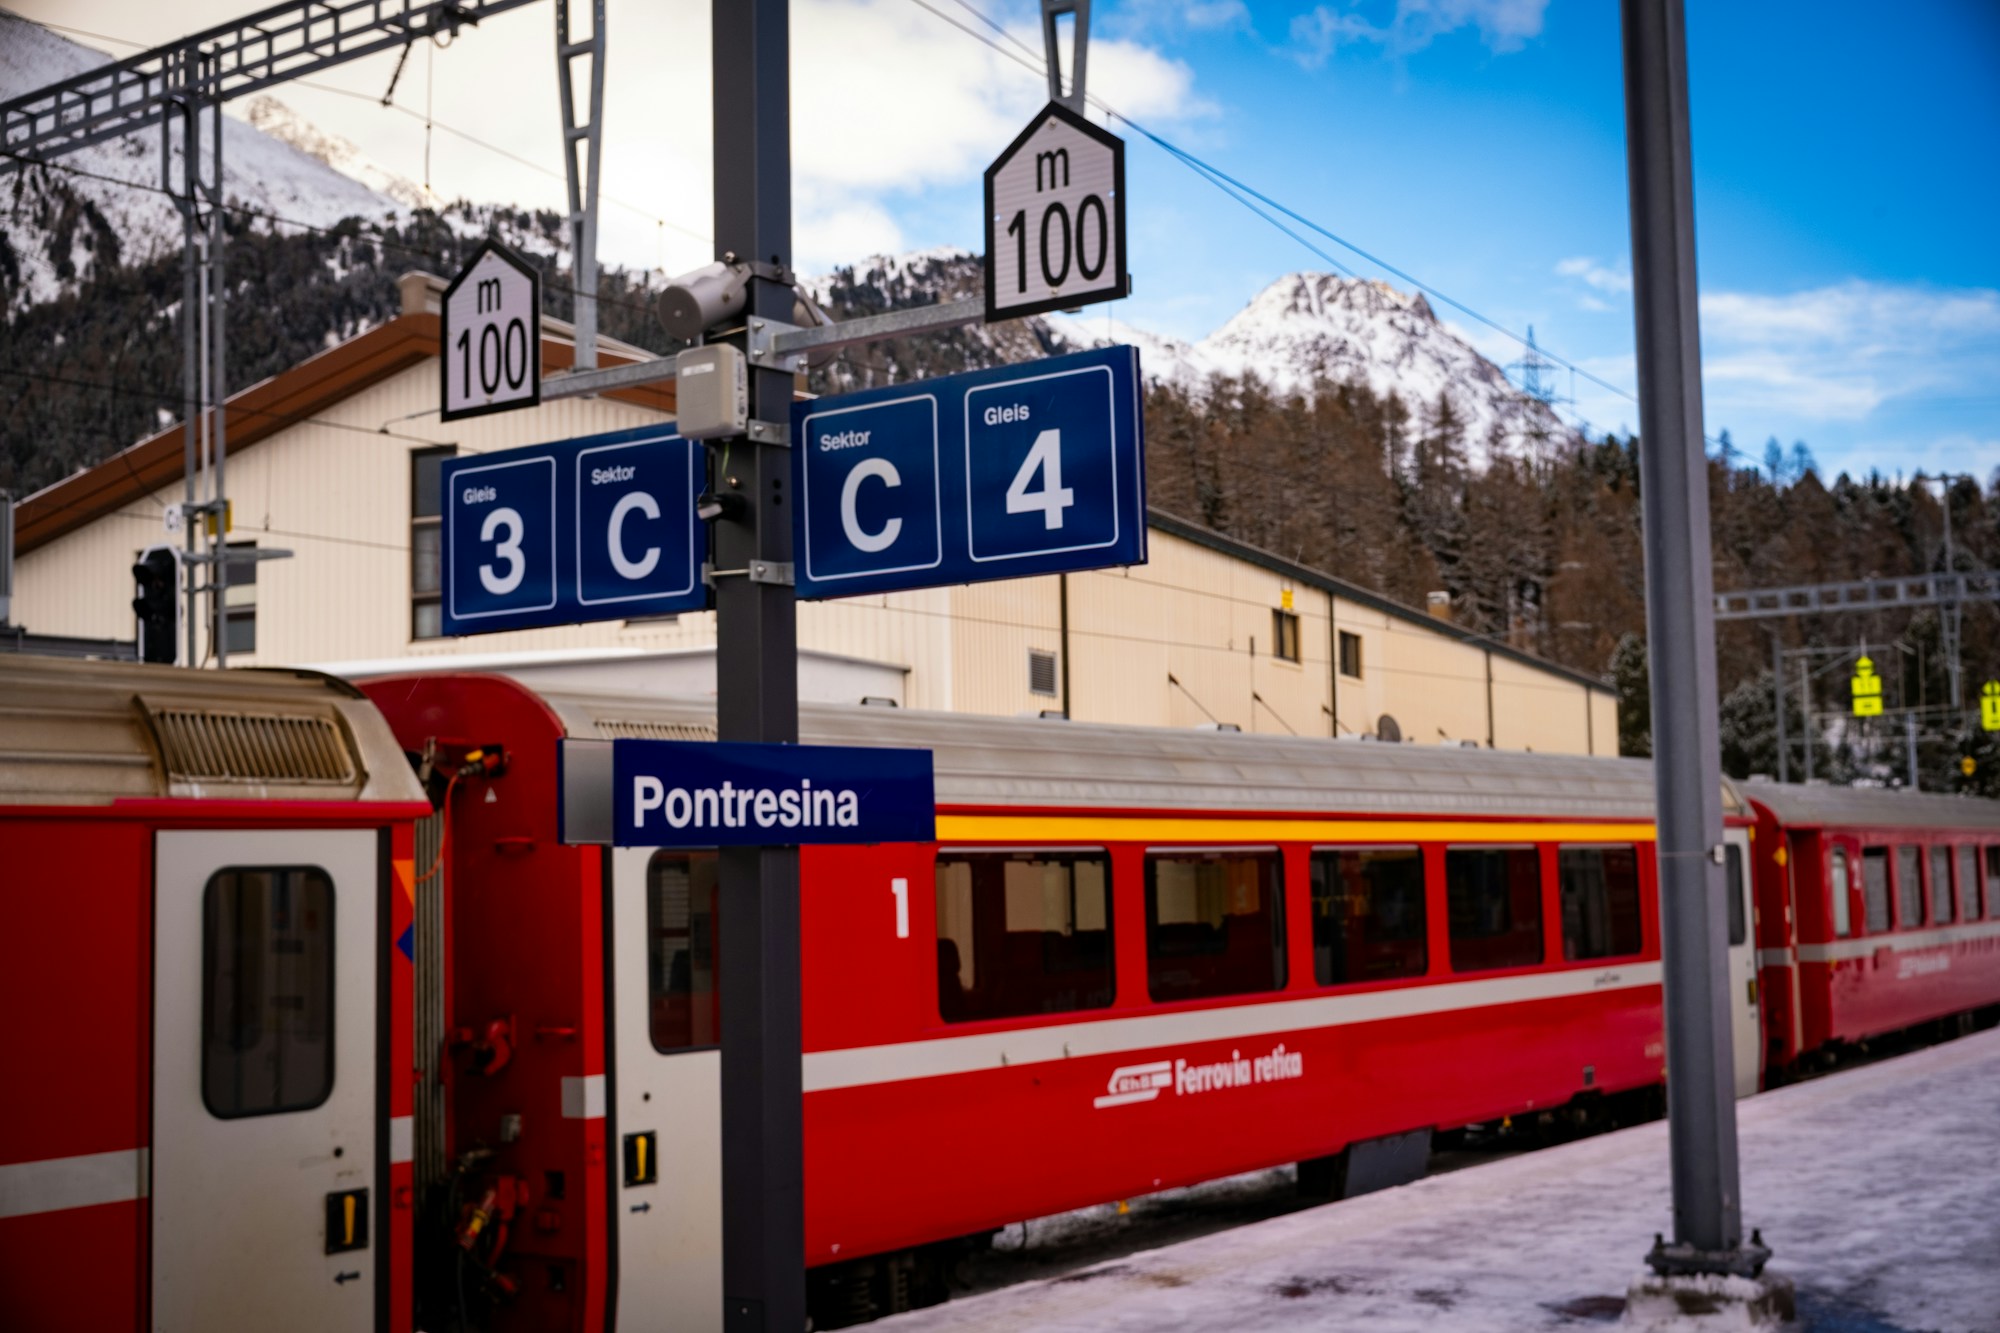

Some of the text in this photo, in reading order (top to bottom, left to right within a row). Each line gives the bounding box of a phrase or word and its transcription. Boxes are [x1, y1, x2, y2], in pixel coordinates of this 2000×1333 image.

[1037, 148, 1069, 193] m
[1008, 194, 1108, 294] 100
[478, 277, 500, 315] m
[457, 317, 527, 399] 100
[820, 430, 871, 452] Sektor
[984, 403, 1030, 426] Gleis
[463, 486, 497, 505] Gleis
[591, 465, 636, 485] Sektor
[1006, 428, 1074, 530] 4
[840, 457, 902, 553] C
[479, 507, 526, 595] 3
[607, 491, 661, 580] C
[633, 775, 859, 829] Pontresina
[891, 877, 909, 938] 1
[1175, 1049, 1252, 1096] Ferrovia
[1253, 1043, 1303, 1083] retica
